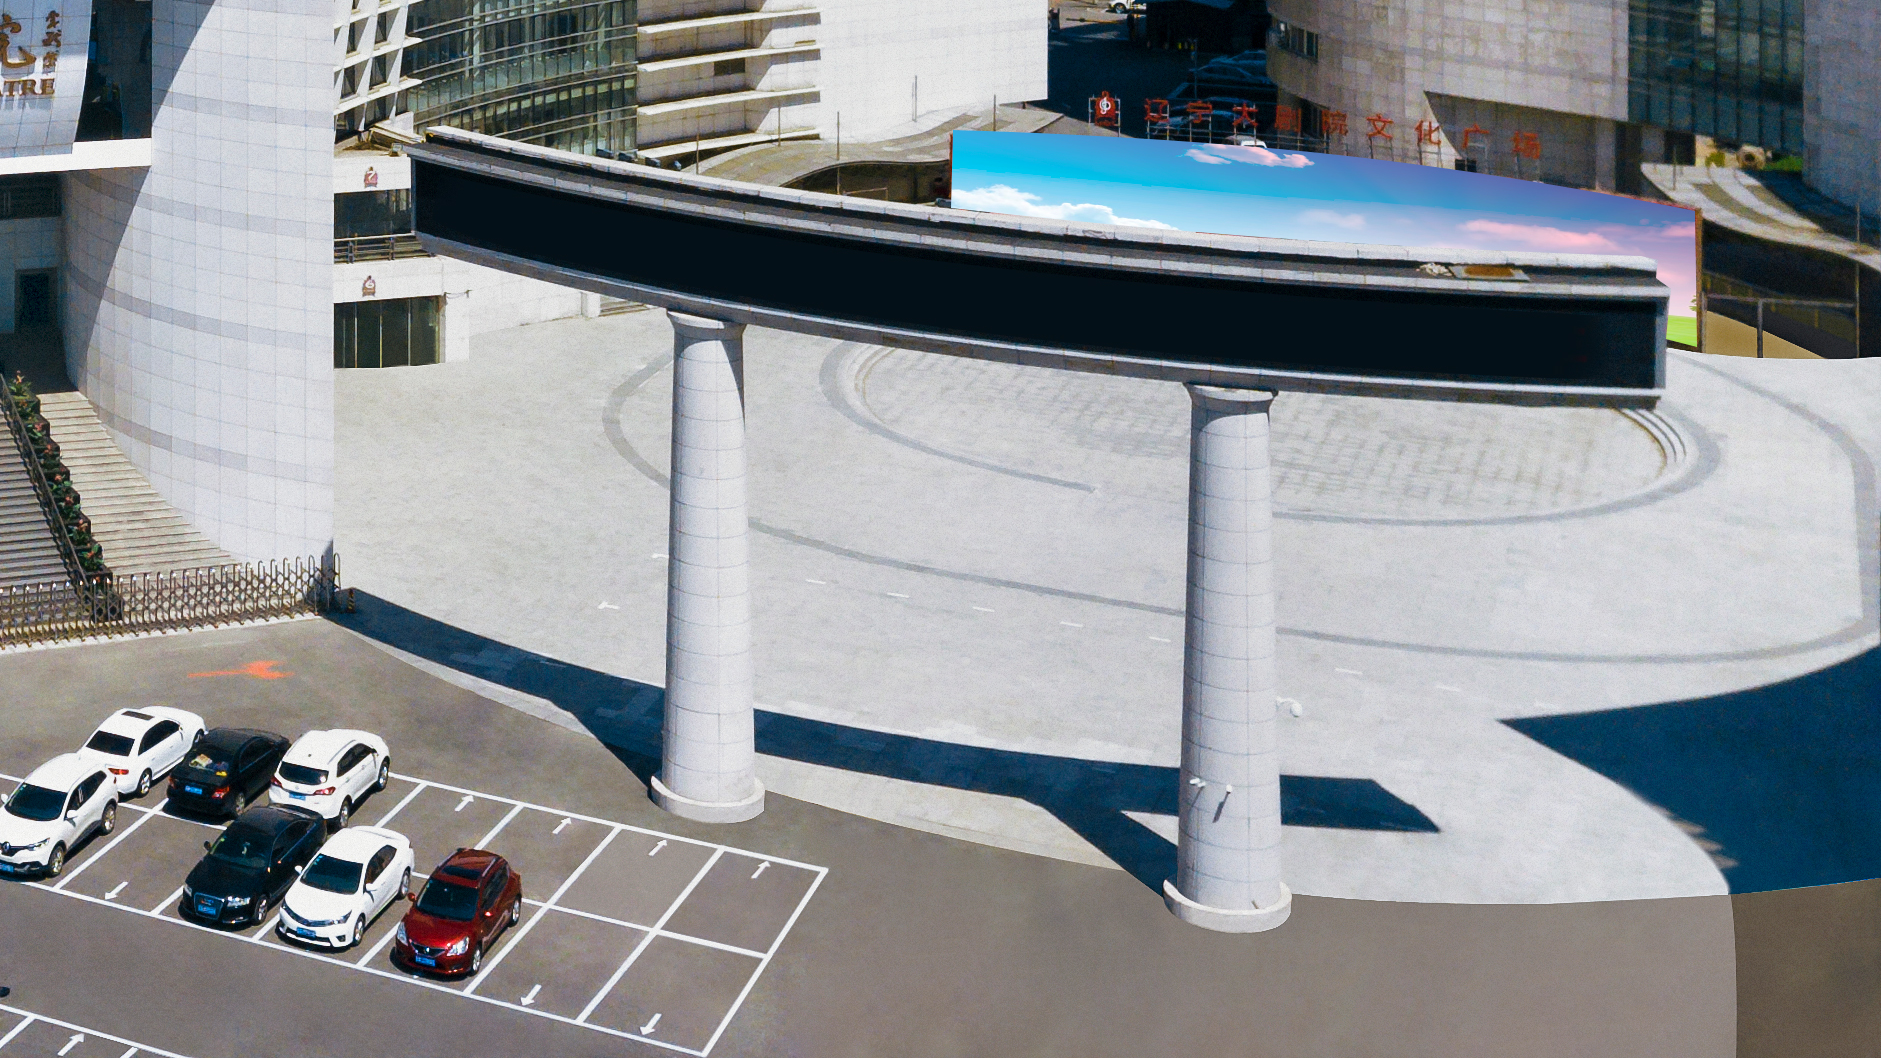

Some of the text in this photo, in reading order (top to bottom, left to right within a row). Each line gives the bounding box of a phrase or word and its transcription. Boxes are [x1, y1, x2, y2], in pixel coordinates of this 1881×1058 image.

[1144, 96, 1540, 160] 辽宁大剧院文化广场
